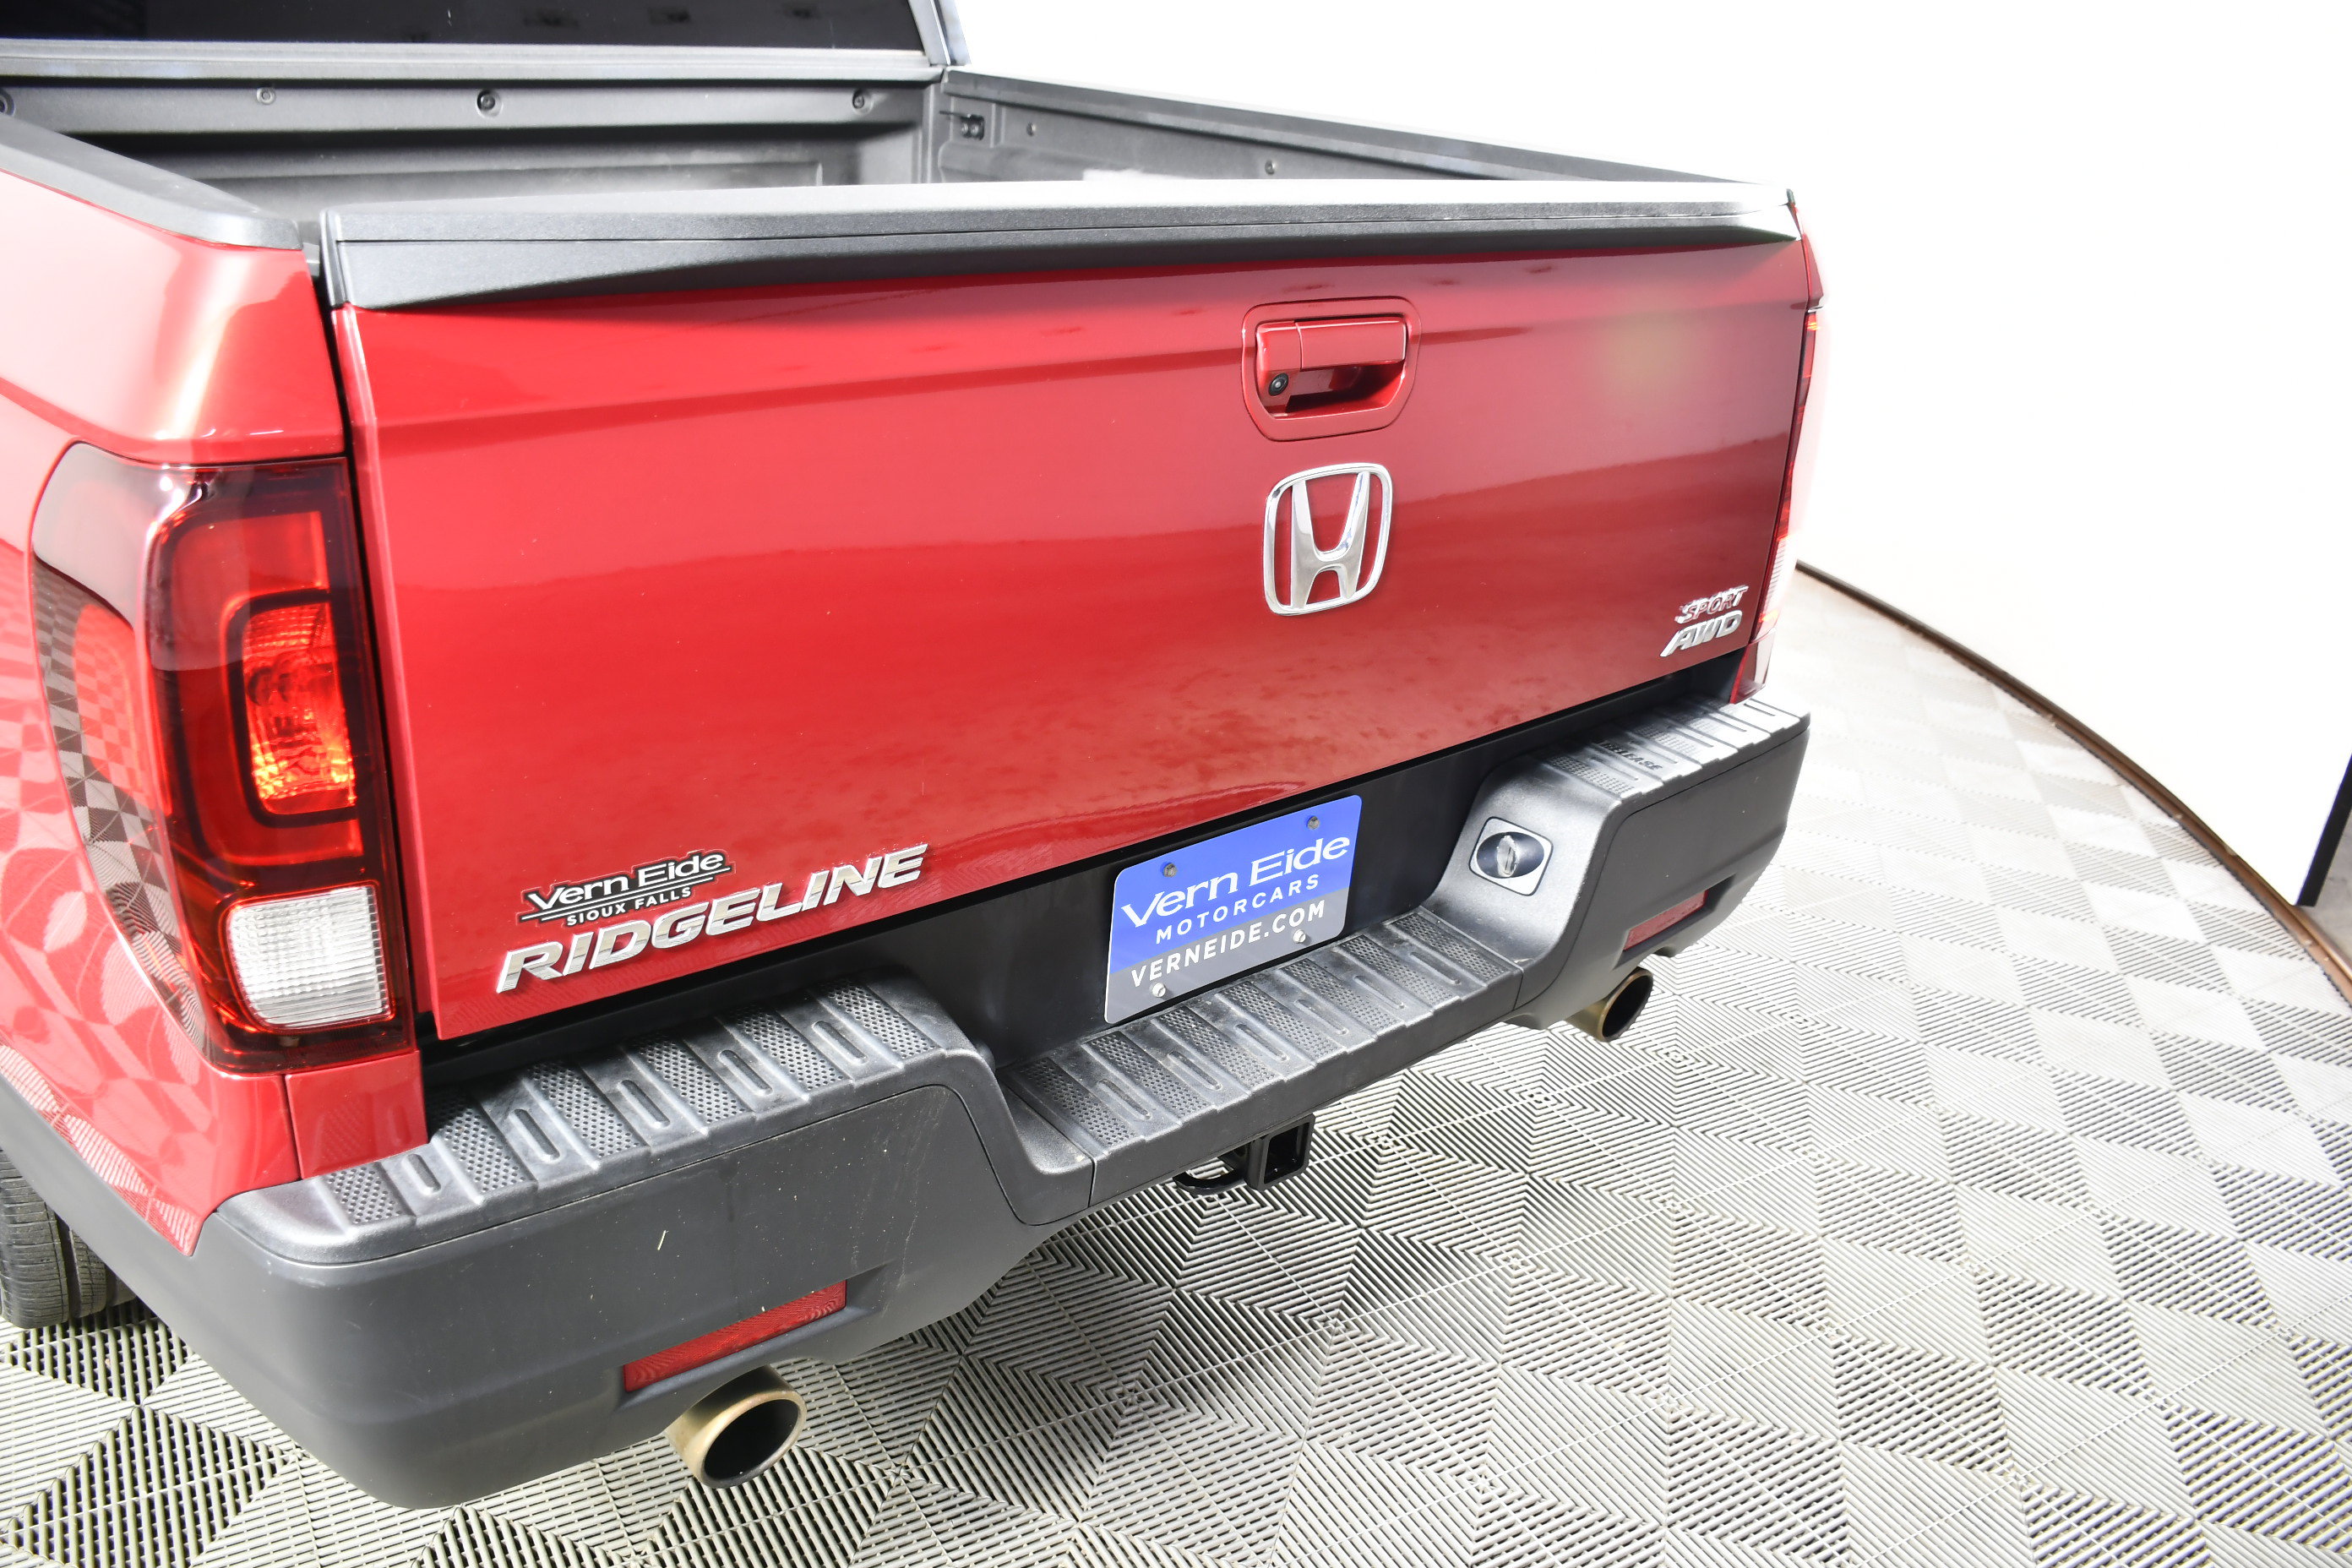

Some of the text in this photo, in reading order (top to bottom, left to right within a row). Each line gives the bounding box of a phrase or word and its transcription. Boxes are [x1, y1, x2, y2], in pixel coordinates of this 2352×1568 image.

[1659, 609, 1743, 657] AWD
[1674, 585, 1749, 623] SPORT
[526, 851, 725, 911] Vern Eide
[566, 887, 692, 927] SIOUX FALLS
[1121, 836, 1350, 928] Vern Eide
[1156, 874, 1319, 945] MOTORCARS
[496, 844, 928, 994] RIDGELINE
[1131, 900, 1325, 988] VERNEIDE.COM
